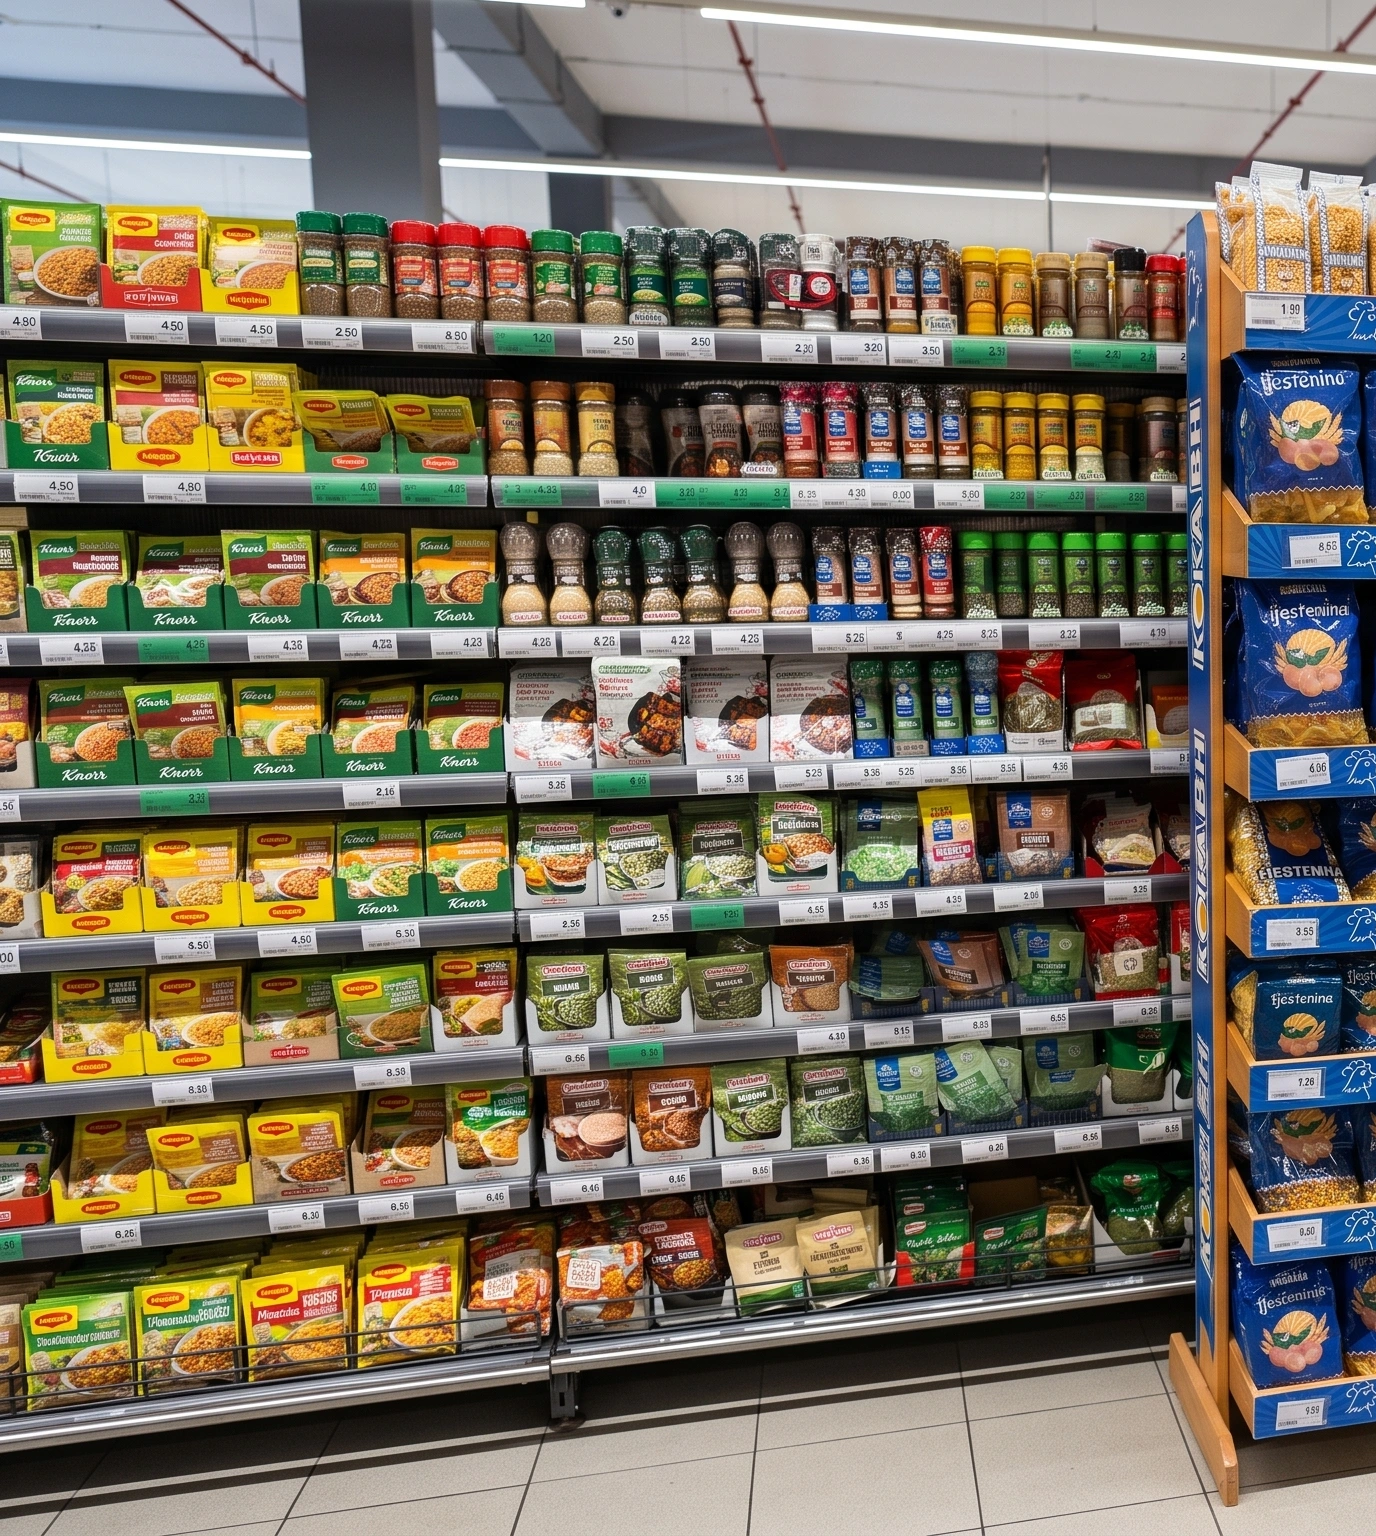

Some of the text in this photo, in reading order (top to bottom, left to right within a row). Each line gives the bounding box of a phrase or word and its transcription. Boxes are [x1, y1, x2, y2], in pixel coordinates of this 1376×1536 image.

[250, 324, 273, 335] 4.50
[691, 336, 711, 346] 2.50
[922, 346, 940, 356] 3.50
[49, 480, 74, 490] 4.50
[177, 481, 201, 491] 4.80
[153, 612, 198, 626] Knorr
[341, 610, 384, 624] Knorr
[346, 760, 386, 773] Knorr
[440, 756, 479, 769] Knorr
[62, 769, 107, 783] Knorr
[159, 766, 203, 780] Knorr
[448, 897, 488, 910] Knorr
[291, 935, 312, 945] 4.50
